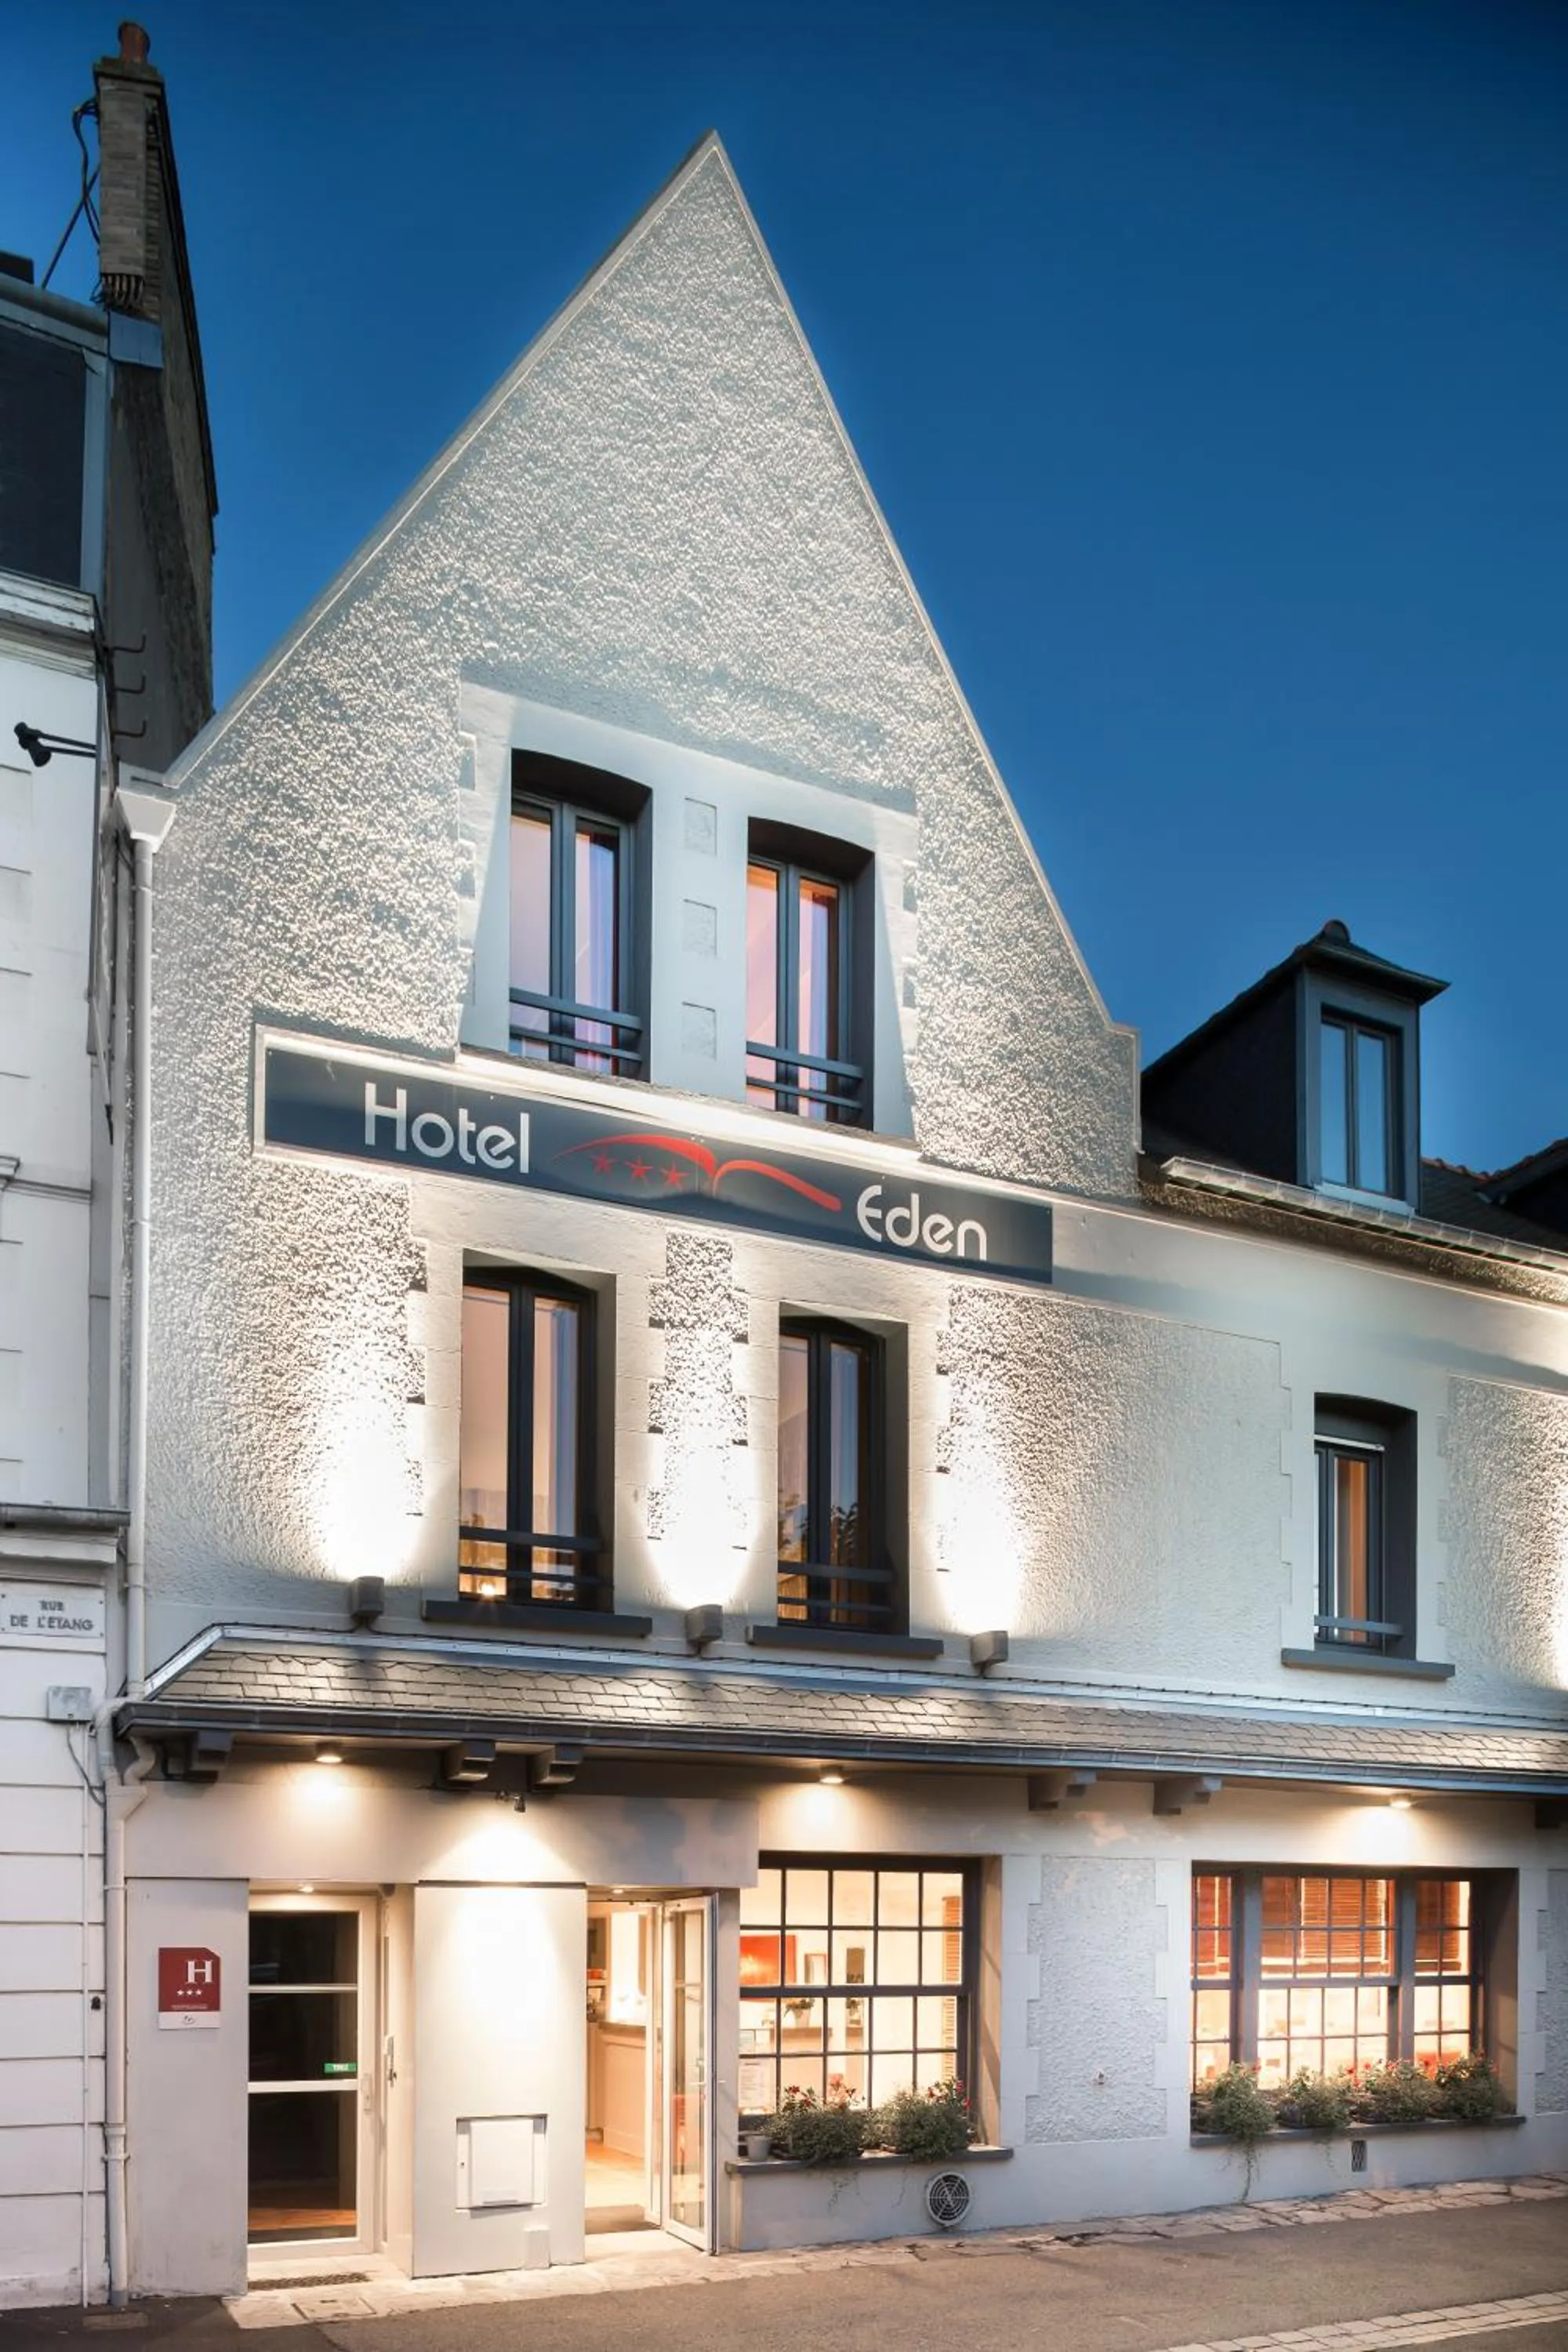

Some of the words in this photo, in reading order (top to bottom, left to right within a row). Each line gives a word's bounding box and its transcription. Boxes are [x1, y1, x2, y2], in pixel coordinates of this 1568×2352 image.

[365, 1082, 530, 1174] Hotel
[857, 1185, 987, 1261] Eden
[39, 1600, 64, 1611] RUE
[10, 1615, 29, 1628] DE
[186, 1960, 213, 1984] H
